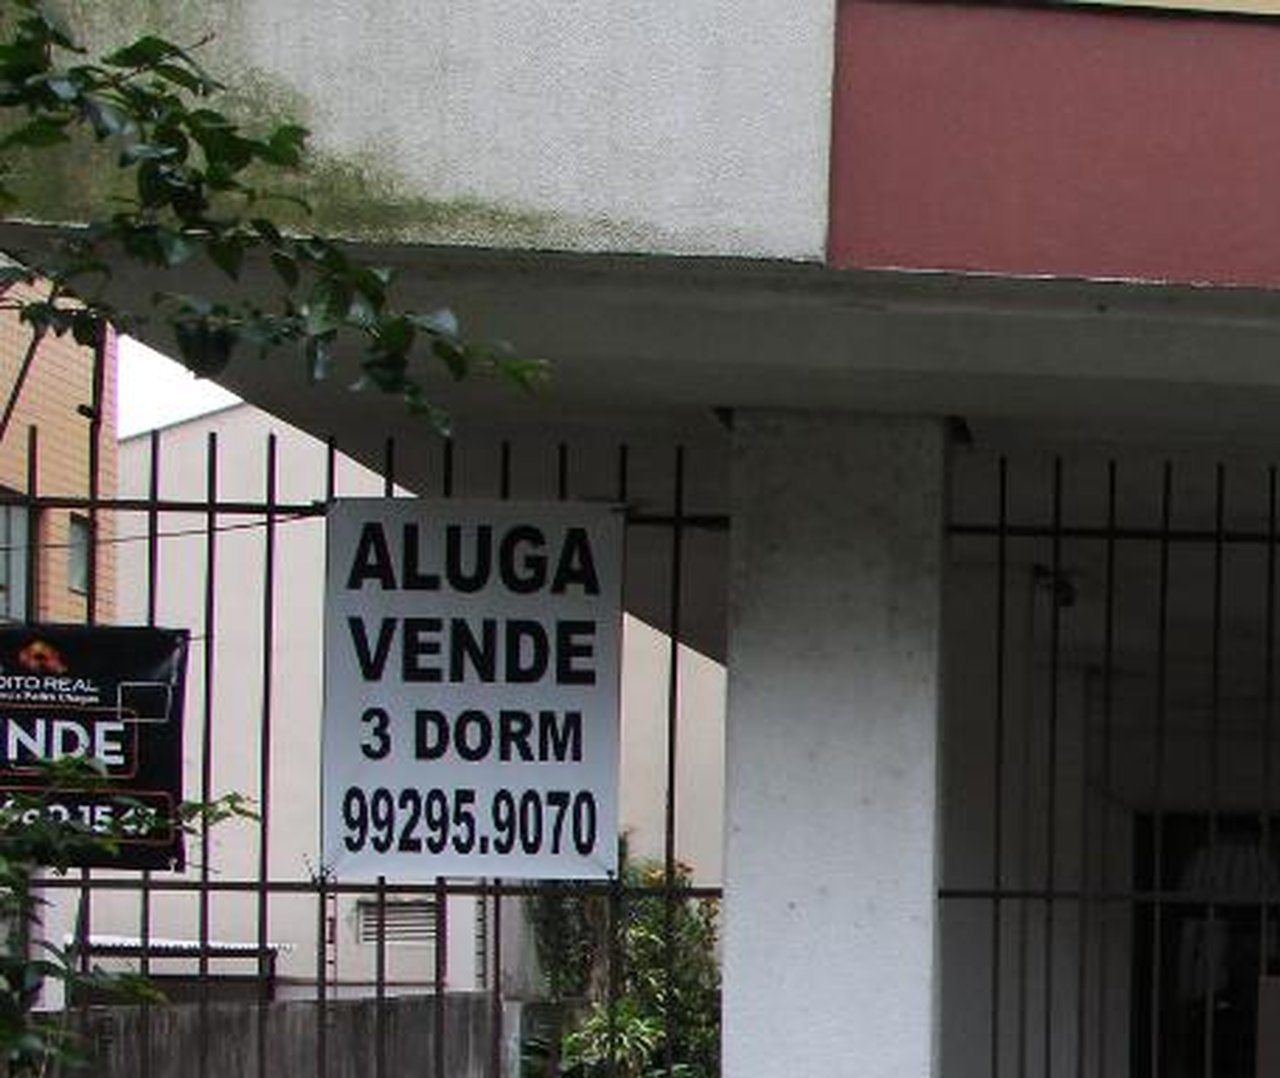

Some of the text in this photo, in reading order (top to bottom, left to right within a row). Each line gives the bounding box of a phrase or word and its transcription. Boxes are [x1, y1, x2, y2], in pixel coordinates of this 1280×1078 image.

[345, 522, 601, 596] ALUGA
[348, 616, 597, 686] VENDE
[43, 677, 99, 693] REAL
[7, 718, 126, 766] NDE
[361, 708, 583, 763] 3 DORM
[342, 786, 597, 856] 99295.9070
